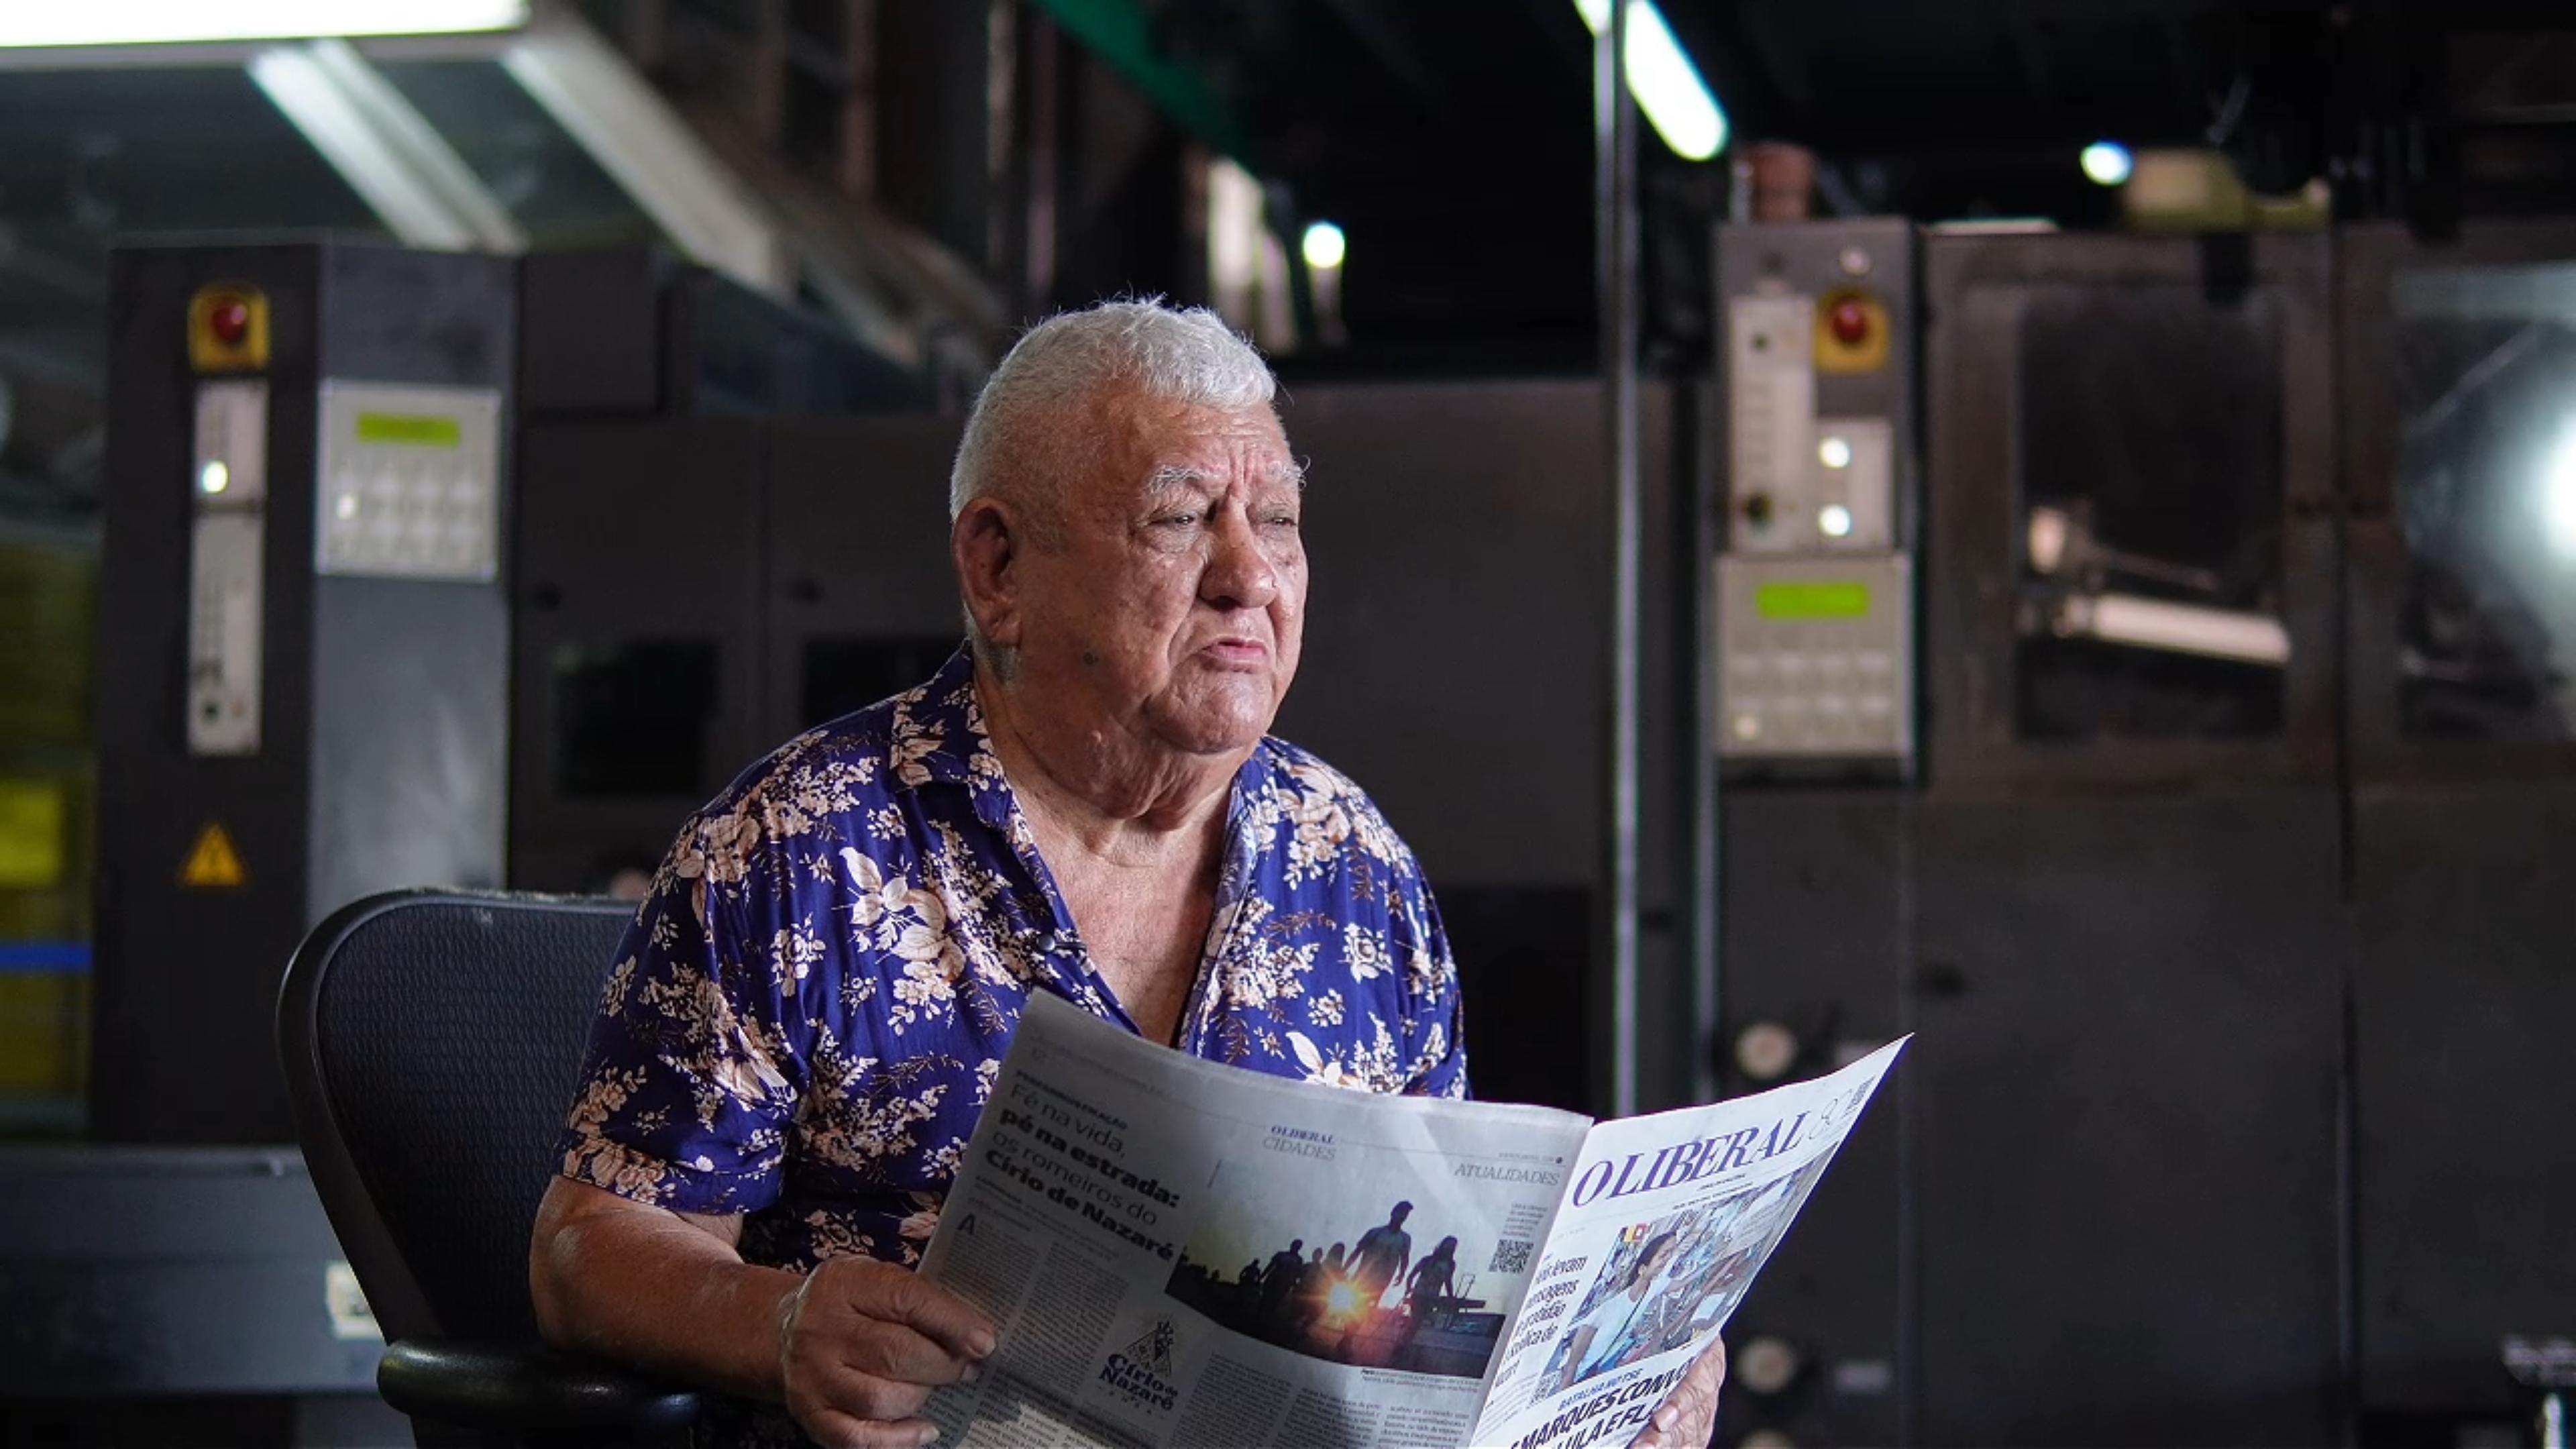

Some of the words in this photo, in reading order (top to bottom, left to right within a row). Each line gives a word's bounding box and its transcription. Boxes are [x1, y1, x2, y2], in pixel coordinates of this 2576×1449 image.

[1010, 1083, 1039, 1110] Fé
[1042, 1104, 1071, 1127] na
[1075, 1116, 1125, 1159] vida,
[1263, 1136, 1336, 1161] CIDADES
[992, 1131, 1018, 1155] os
[1021, 1148, 1123, 1209] romeiros
[1126, 1201, 1158, 1226] do
[999, 1108, 1034, 1134] pé
[1035, 1127, 1067, 1153] na
[1070, 1146, 1181, 1208] estrada:
[1454, 1163, 1561, 1186] ATUALIDADES
[1572, 1159, 1614, 1209] O
[1606, 1110, 1811, 1199] LIBERAL
[985, 1148, 1044, 1192] Círio
[1047, 1187, 1079, 1211] de
[1081, 1201, 1174, 1261] Nazaré
[1098, 1363, 1175, 1411] Nazaré
[1108, 1353, 1165, 1392] Círio
[1521, 1387, 1622, 1449] MARQUES
[1603, 1409, 1624, 1437] E
